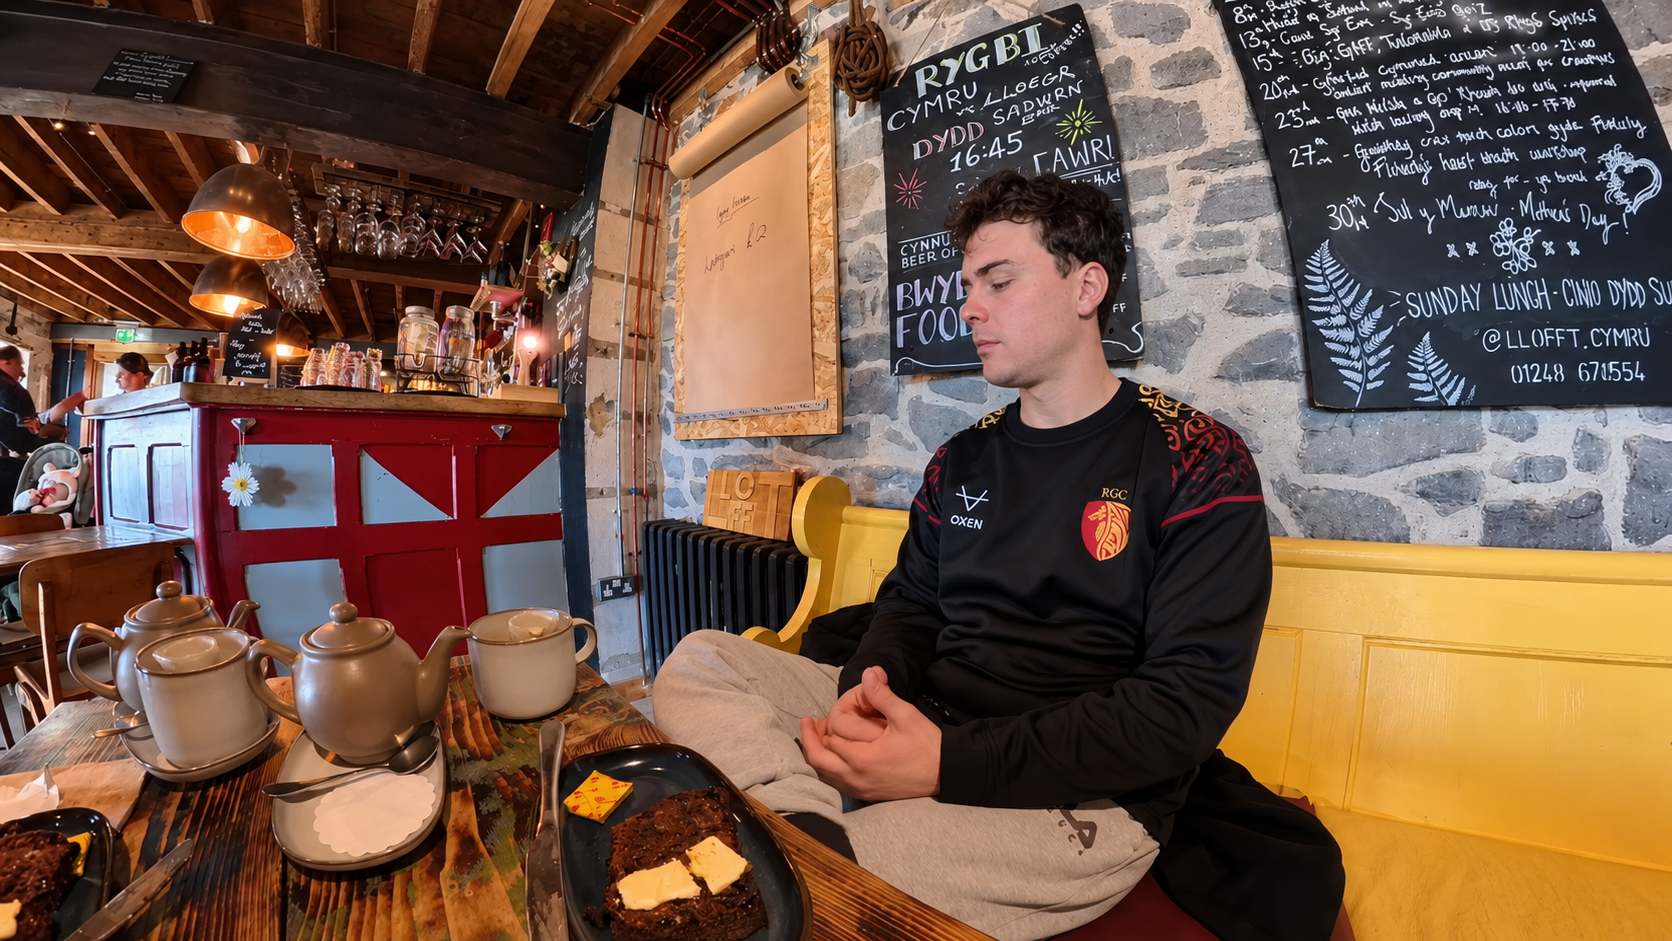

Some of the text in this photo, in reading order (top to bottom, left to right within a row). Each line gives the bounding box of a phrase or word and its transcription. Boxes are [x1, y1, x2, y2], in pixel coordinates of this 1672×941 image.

[914, 22, 1048, 98] RYGBI
[887, 82, 978, 132] CYMRU
[912, 122, 985, 160] DYDD
[993, 80, 1083, 126] SADWRN
[950, 130, 1023, 173] 16:45
[900, 233, 951, 257] CYNNU
[901, 247, 959, 269] BEER OF
[1406, 283, 1482, 319] SUNDAY
[1561, 278, 1601, 308] CINIO
[1607, 277, 1647, 311] DYDD
[1648, 276, 1672, 306] SU
[1482, 327, 1651, 353] @LLOFFT.CYMRU
[1511, 363, 1565, 384] 01248
[1101, 487, 1128, 500] RGC
[950, 514, 983, 530] OXEN
